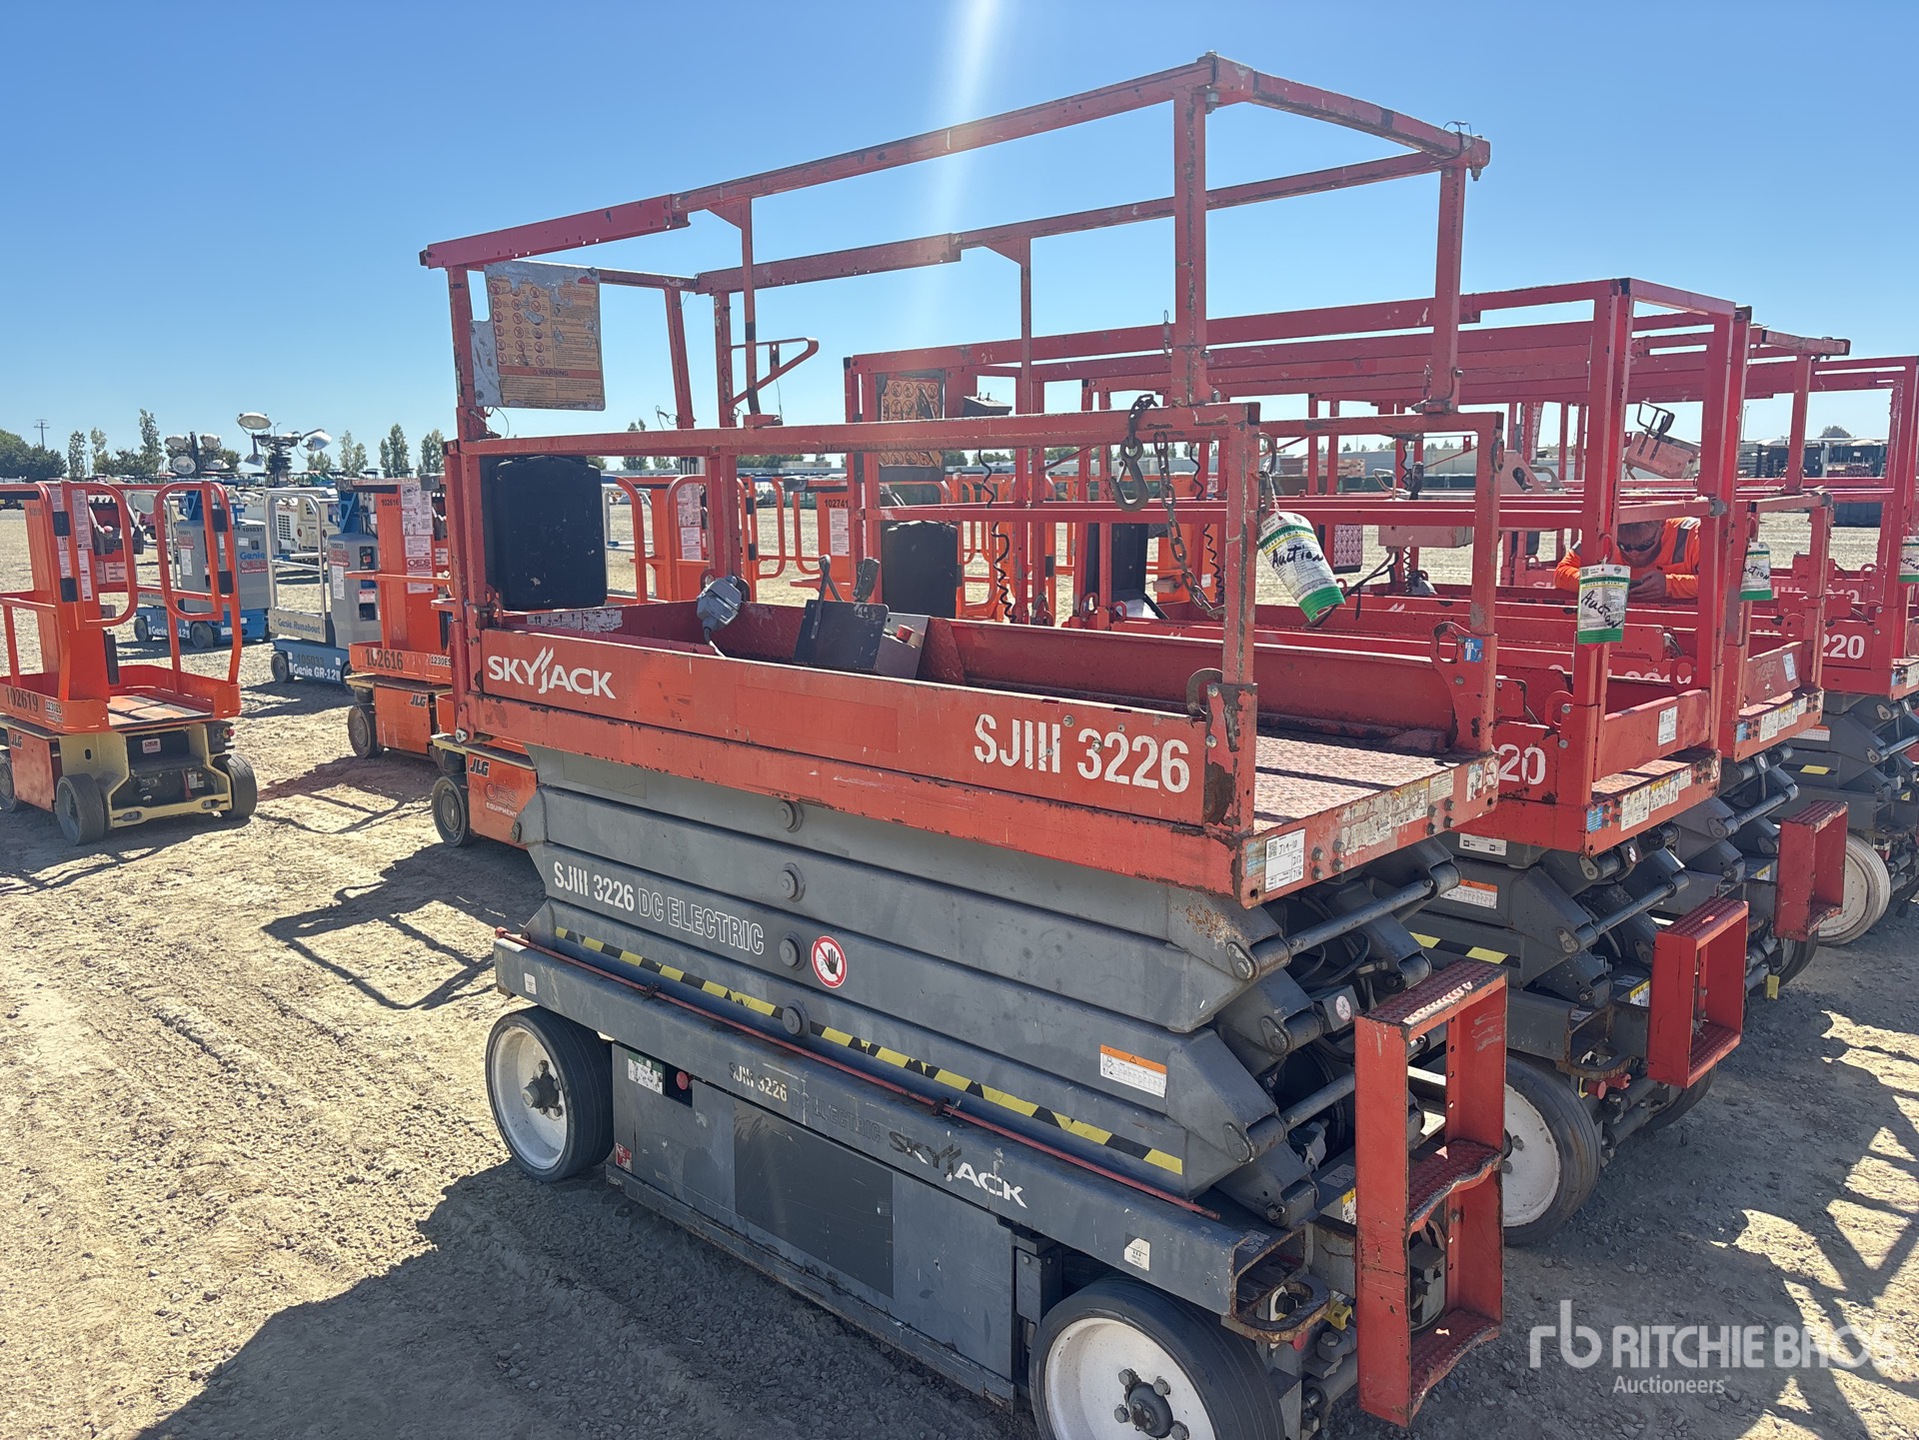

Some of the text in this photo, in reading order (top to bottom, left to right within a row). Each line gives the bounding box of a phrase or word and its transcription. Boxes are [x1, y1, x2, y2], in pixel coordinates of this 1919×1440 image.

[824, 499, 848, 508] 102741
[488, 645, 616, 700] SKYJACK
[5, 686, 39, 712] 102619
[410, 693, 427, 707] JLG
[469, 757, 490, 777] JLG
[1076, 728, 1191, 793] 3226
[593, 874, 635, 912] 3226
[638, 887, 664, 922] DC
[667, 896, 765, 955] ELECTRIC
[758, 1075, 788, 1102] 3226
